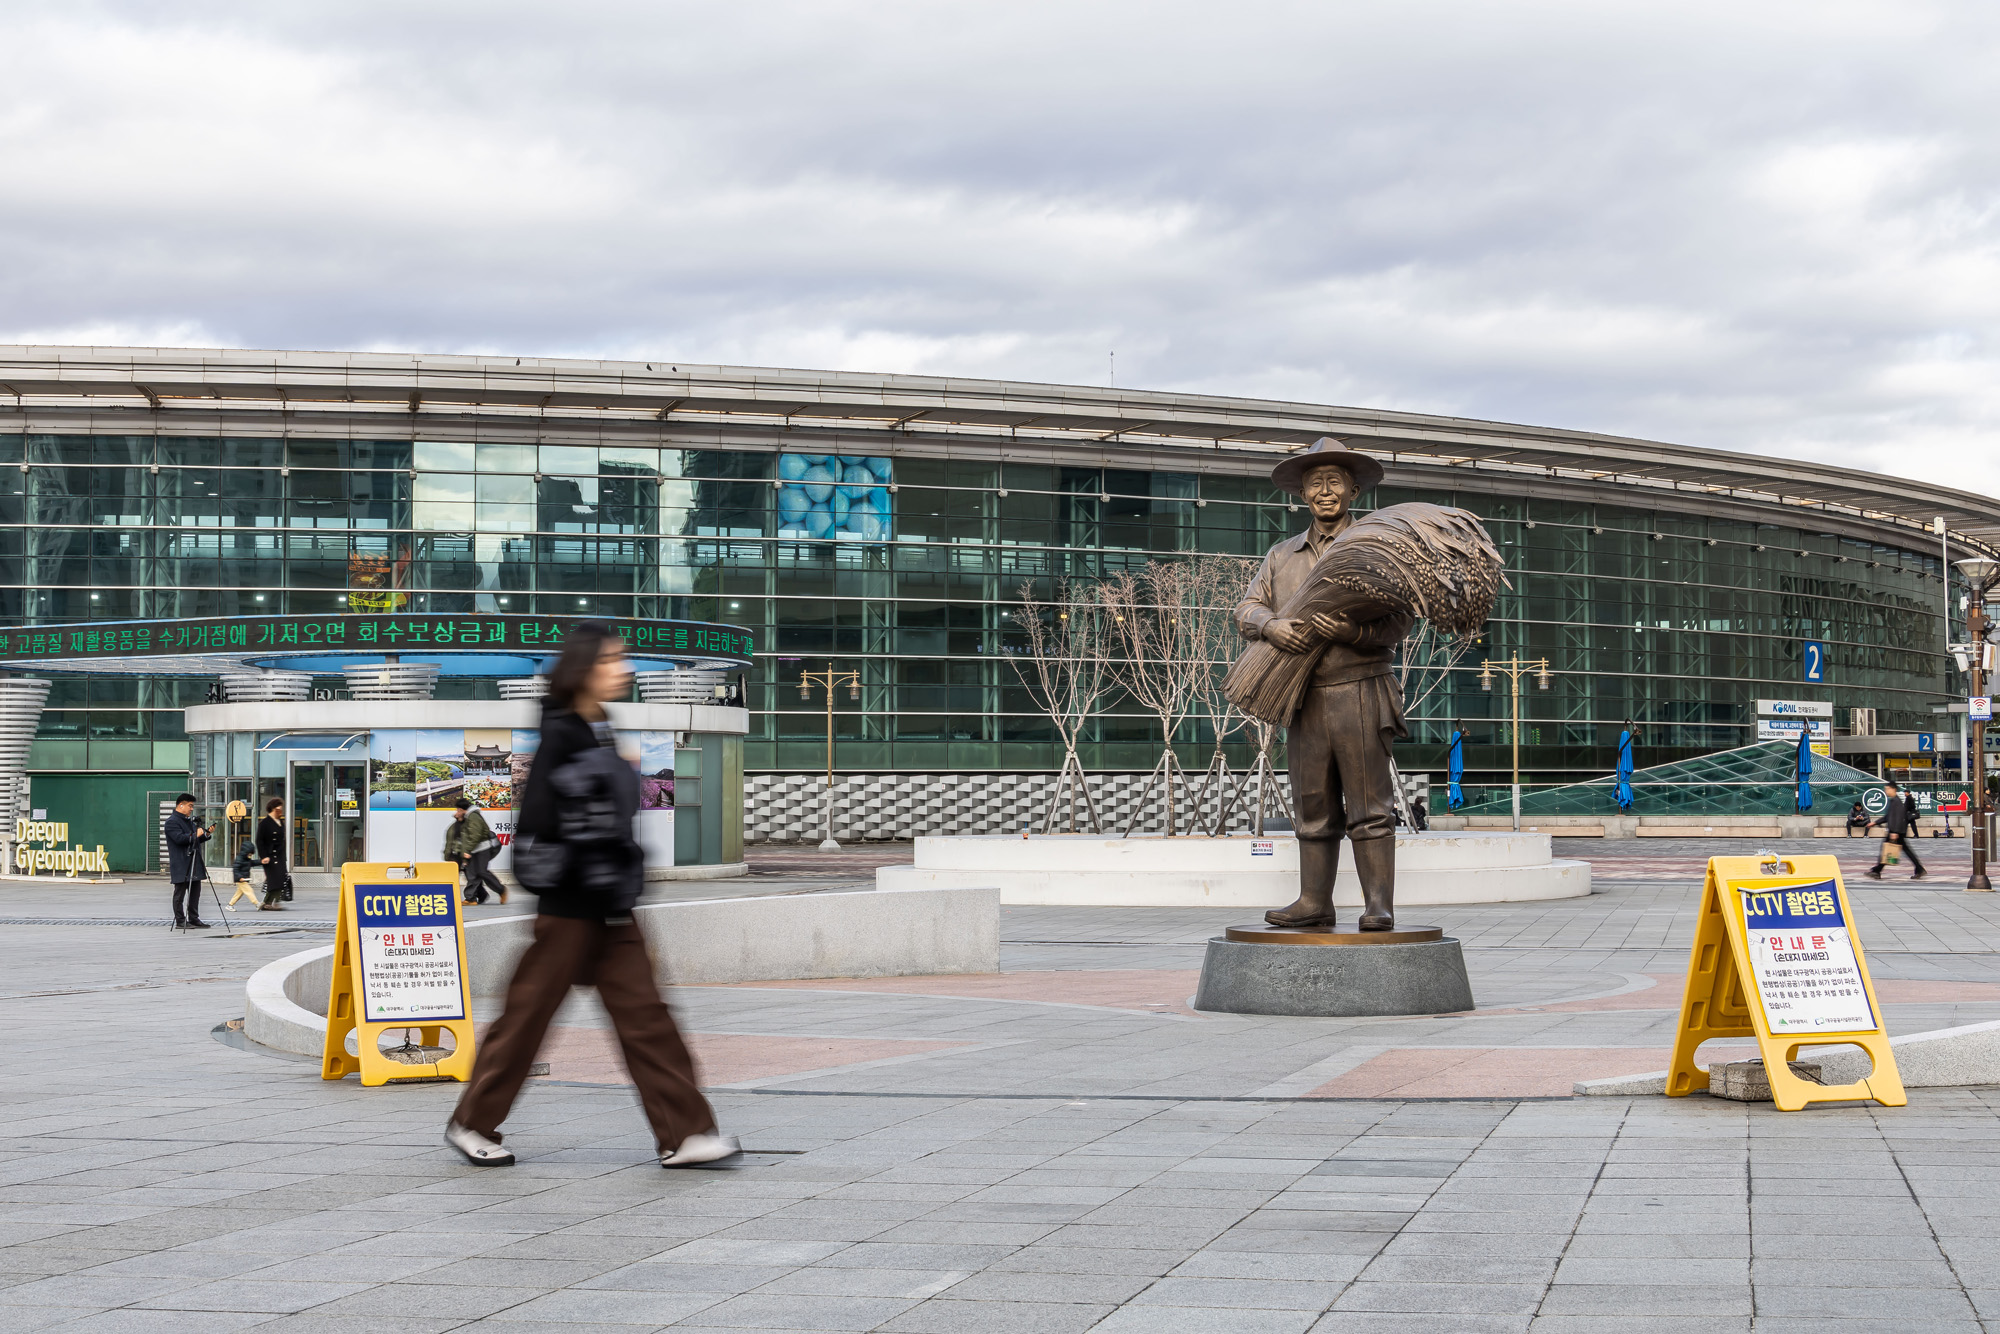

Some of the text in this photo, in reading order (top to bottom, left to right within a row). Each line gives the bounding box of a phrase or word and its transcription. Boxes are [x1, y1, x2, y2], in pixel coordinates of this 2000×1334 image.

[15, 632, 62, 654] 고품질
[70, 628, 152, 652] 재활용품을
[158, 624, 247, 649] 수거거점에
[257, 621, 345, 645] 가져오면
[356, 621, 507, 644] 회수보상금과
[519, 621, 689, 649] 탄소포인트를
[695, 630, 740, 654] 지급하는
[1808, 645, 1820, 679] 2
[1773, 702, 1797, 713] KORAIL
[1922, 735, 1930, 750] 2
[1937, 791, 1956, 800] 55m
[16, 818, 68, 848] Daegu
[16, 844, 109, 877] Gyeongbuk
[363, 894, 448, 916] CCTV 촬영중
[1746, 891, 1836, 916] CCTV 촬영중
[384, 947, 434, 956] (손대지 마세요)
[1774, 951, 1829, 962] (손대지 마세요)
[1793, 968, 1820, 976] 대구광역시
[1821, 967, 1853, 976] 공공시설로서
